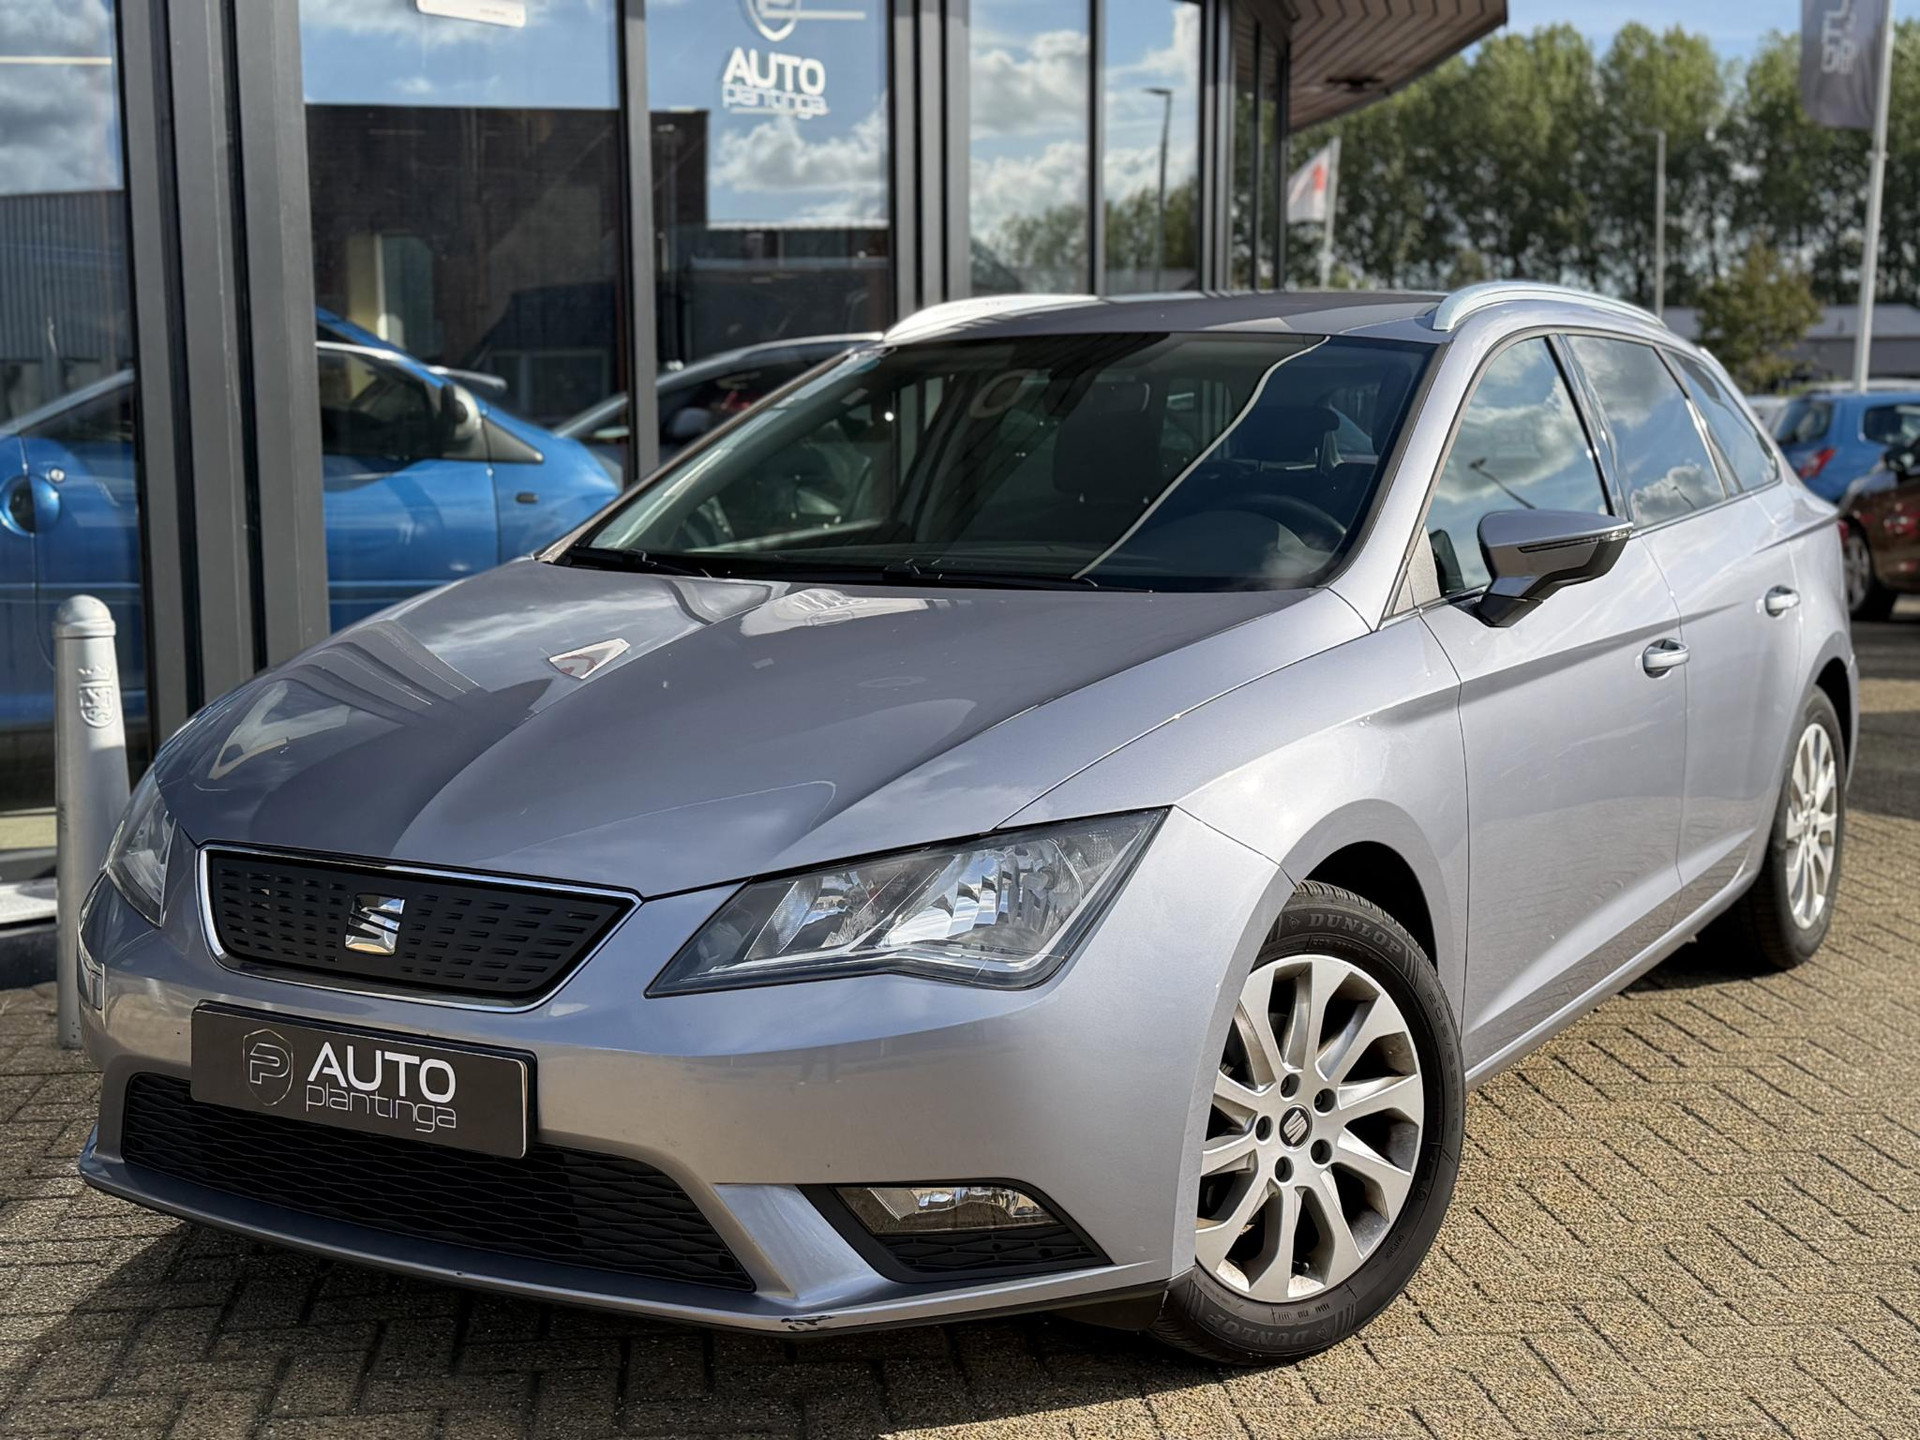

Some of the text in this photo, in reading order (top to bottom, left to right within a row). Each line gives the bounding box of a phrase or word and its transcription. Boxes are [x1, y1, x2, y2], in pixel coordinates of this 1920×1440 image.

[722, 46, 826, 96] AUTO
[1308, 912, 1402, 954] DUNLOP
[307, 1041, 456, 1104] AUTO
[305, 1081, 457, 1133] plantinga
